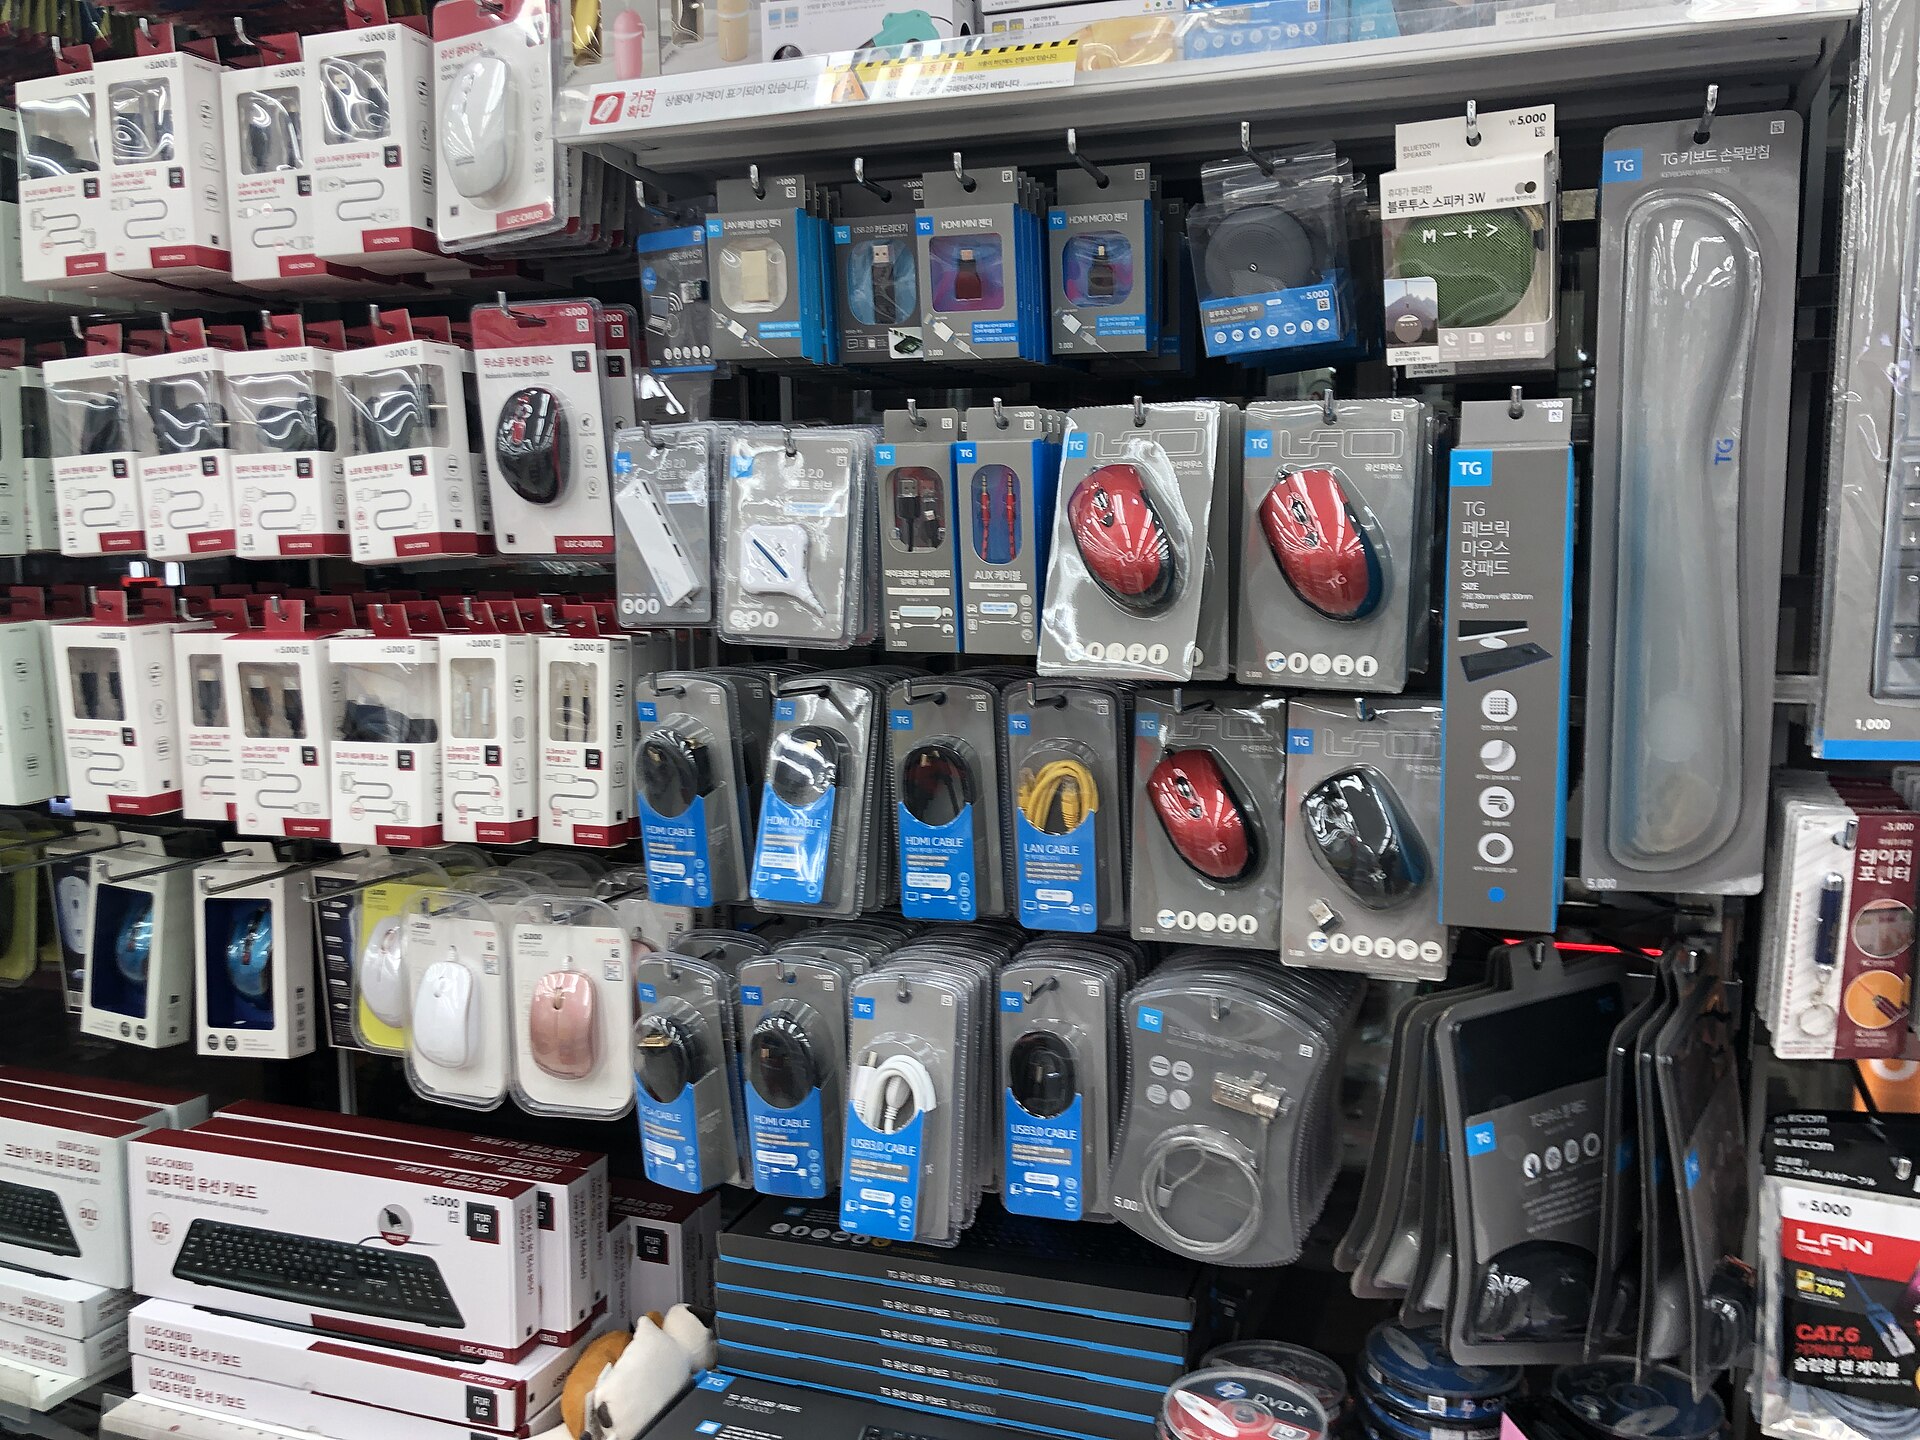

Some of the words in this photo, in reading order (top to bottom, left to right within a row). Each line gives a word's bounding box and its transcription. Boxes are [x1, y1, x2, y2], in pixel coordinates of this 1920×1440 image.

[631, 88, 657, 105] 가격
[665, 94, 694, 107] 상품에
[695, 91, 724, 102] 가격이
[726, 83, 765, 99] 표기되어
[767, 79, 809, 95] 있습니다.
[626, 103, 652, 119] 확인
[1403, 142, 1440, 152] BLUETOOTH
[1403, 150, 1432, 159] SPEAKER
[1661, 153, 1678, 165] TG
[1680, 150, 1718, 165] 키보드
[1719, 145, 1770, 162] 손목받침
[1614, 159, 1634, 173] TG
[1661, 170, 1694, 178] KEYBOARD
[1388, 188, 1409, 197] 휴대가
[1410, 185, 1433, 196] 편리한
[1387, 198, 1430, 214] 블루투스
[1432, 194, 1465, 208] 스피커
[1468, 192, 1486, 205] 3W
[724, 221, 737, 231] LAN
[768, 218, 782, 229] 젠더
[941, 220, 960, 230] HDMI
[961, 219, 977, 229] MINI
[978, 217, 993, 228] 젠더
[1052, 217, 1063, 225] TG
[1069, 215, 1087, 225] HDMI
[1088, 213, 1113, 223] MICRO
[1113, 212, 1128, 222] 젠더
[709, 225, 719, 233] TG
[854, 225, 866, 234] USB
[866, 225, 875, 234] 2.0
[875, 223, 909, 234] 카드리더기
[919, 221, 931, 230] TG
[837, 231, 847, 239] TG
[1069, 439, 1083, 450] TG
[1252, 439, 1268, 450] TG
[879, 451, 891, 460] TG
[960, 449, 973, 458] TG
[1714, 439, 1734, 465] TG
[808, 468, 824, 478] 2.0
[1458, 461, 1482, 476] TG
[813, 480, 833, 491] 허브
[1463, 501, 1486, 516] TG
[1462, 521, 1510, 538] 페브릭
[1462, 540, 1511, 557] 마우스
[1461, 559, 1510, 577] 장패드
[975, 570, 993, 580] AUX
[993, 569, 1021, 581] 케이블
[1327, 575, 1347, 589] TG
[1461, 582, 1479, 591] SIZE
[642, 708, 653, 716] TG
[781, 707, 792, 715] TG
[896, 716, 909, 724] TG
[1013, 720, 1026, 729] TG
[1141, 720, 1155, 729] TG
[1293, 736, 1309, 747] TG
[766, 816, 789, 827] HDMI
[791, 818, 821, 829] CABLE
[646, 825, 666, 836] HDMI
[667, 826, 695, 838] CABLE
[905, 836, 930, 846] HDMI
[932, 837, 964, 848] CABLE
[1024, 843, 1044, 854] LAN
[1046, 844, 1079, 856] CABLE
[1859, 849, 1912, 865] 레이저
[1857, 867, 1911, 885] 포인터
[642, 988, 654, 997] TG
[745, 991, 759, 1000] TG
[858, 1004, 871, 1012] TG
[1006, 997, 1019, 1006] TG
[1143, 1015, 1158, 1025] TG
[658, 1110, 682, 1123] CABLE
[754, 1114, 778, 1126] HDMI
[780, 1117, 810, 1129] CABLE
[1011, 1123, 1044, 1137] USB3.0
[1046, 1127, 1078, 1141] CABLE
[1476, 1130, 1491, 1145] TG
[851, 1137, 884, 1151] USB3.0
[885, 1141, 917, 1157] CABLE
[146, 1170, 171, 1186] USB
[173, 1173, 195, 1191] 타입
[198, 1178, 221, 1195] 유선
[223, 1182, 259, 1199] 키보드
[473, 1212, 492, 1223] FOR
[1796, 1228, 1874, 1256] LAN
[887, 1269, 898, 1278] TG
[917, 1274, 932, 1284] USB
[1815, 1283, 1846, 1299] 70%
[881, 1299, 893, 1308] TG
[911, 1304, 927, 1314] USB
[880, 1328, 891, 1338] TG
[909, 1333, 925, 1343] USB
[1795, 1323, 1860, 1343] CAT.6
[145, 1338, 166, 1352] USB
[169, 1341, 188, 1357] 타입
[189, 1345, 209, 1362] 유선
[211, 1350, 242, 1368] 키보드
[881, 1358, 893, 1368] TG
[910, 1364, 926, 1373] USB
[1855, 1360, 1900, 1378] 케이블
[707, 1377, 725, 1387] TG
[150, 1378, 171, 1393] USB
[172, 1382, 192, 1398] 타입
[194, 1386, 214, 1403] 유선
[215, 1391, 247, 1410] 키보드
[880, 1386, 891, 1396] TG
[908, 1391, 924, 1402] USB
[473, 1396, 490, 1406] FOR
[1252, 1393, 1309, 1417] DVD-R
